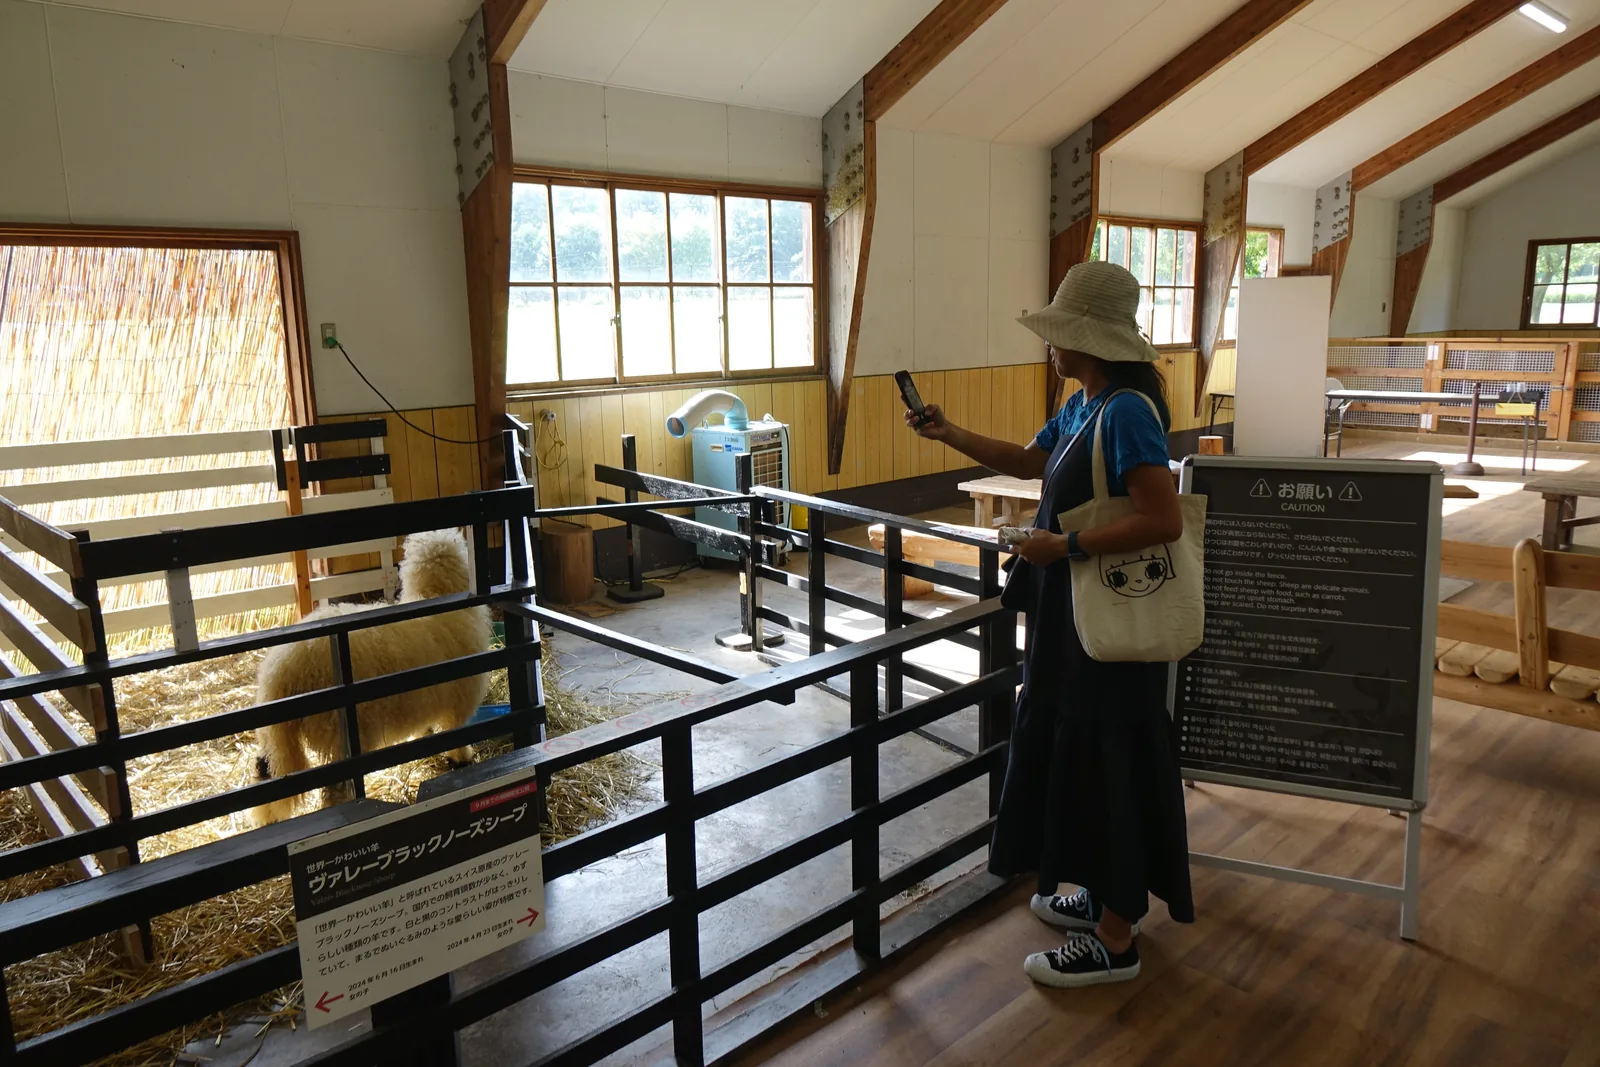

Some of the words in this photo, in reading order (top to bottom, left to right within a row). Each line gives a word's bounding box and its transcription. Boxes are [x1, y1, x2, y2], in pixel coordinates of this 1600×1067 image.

[1278, 483, 1332, 499] お願い
[1281, 503, 1325, 512] CAUTION
[1321, 608, 1343, 616] sheep.
[308, 803, 528, 894] ヴァレーブラックノーズシープ
[306, 842, 380, 874] 世界一かわいい羊
[496, 927, 514, 940] 女の子
[349, 988, 370, 1002] 女の子
